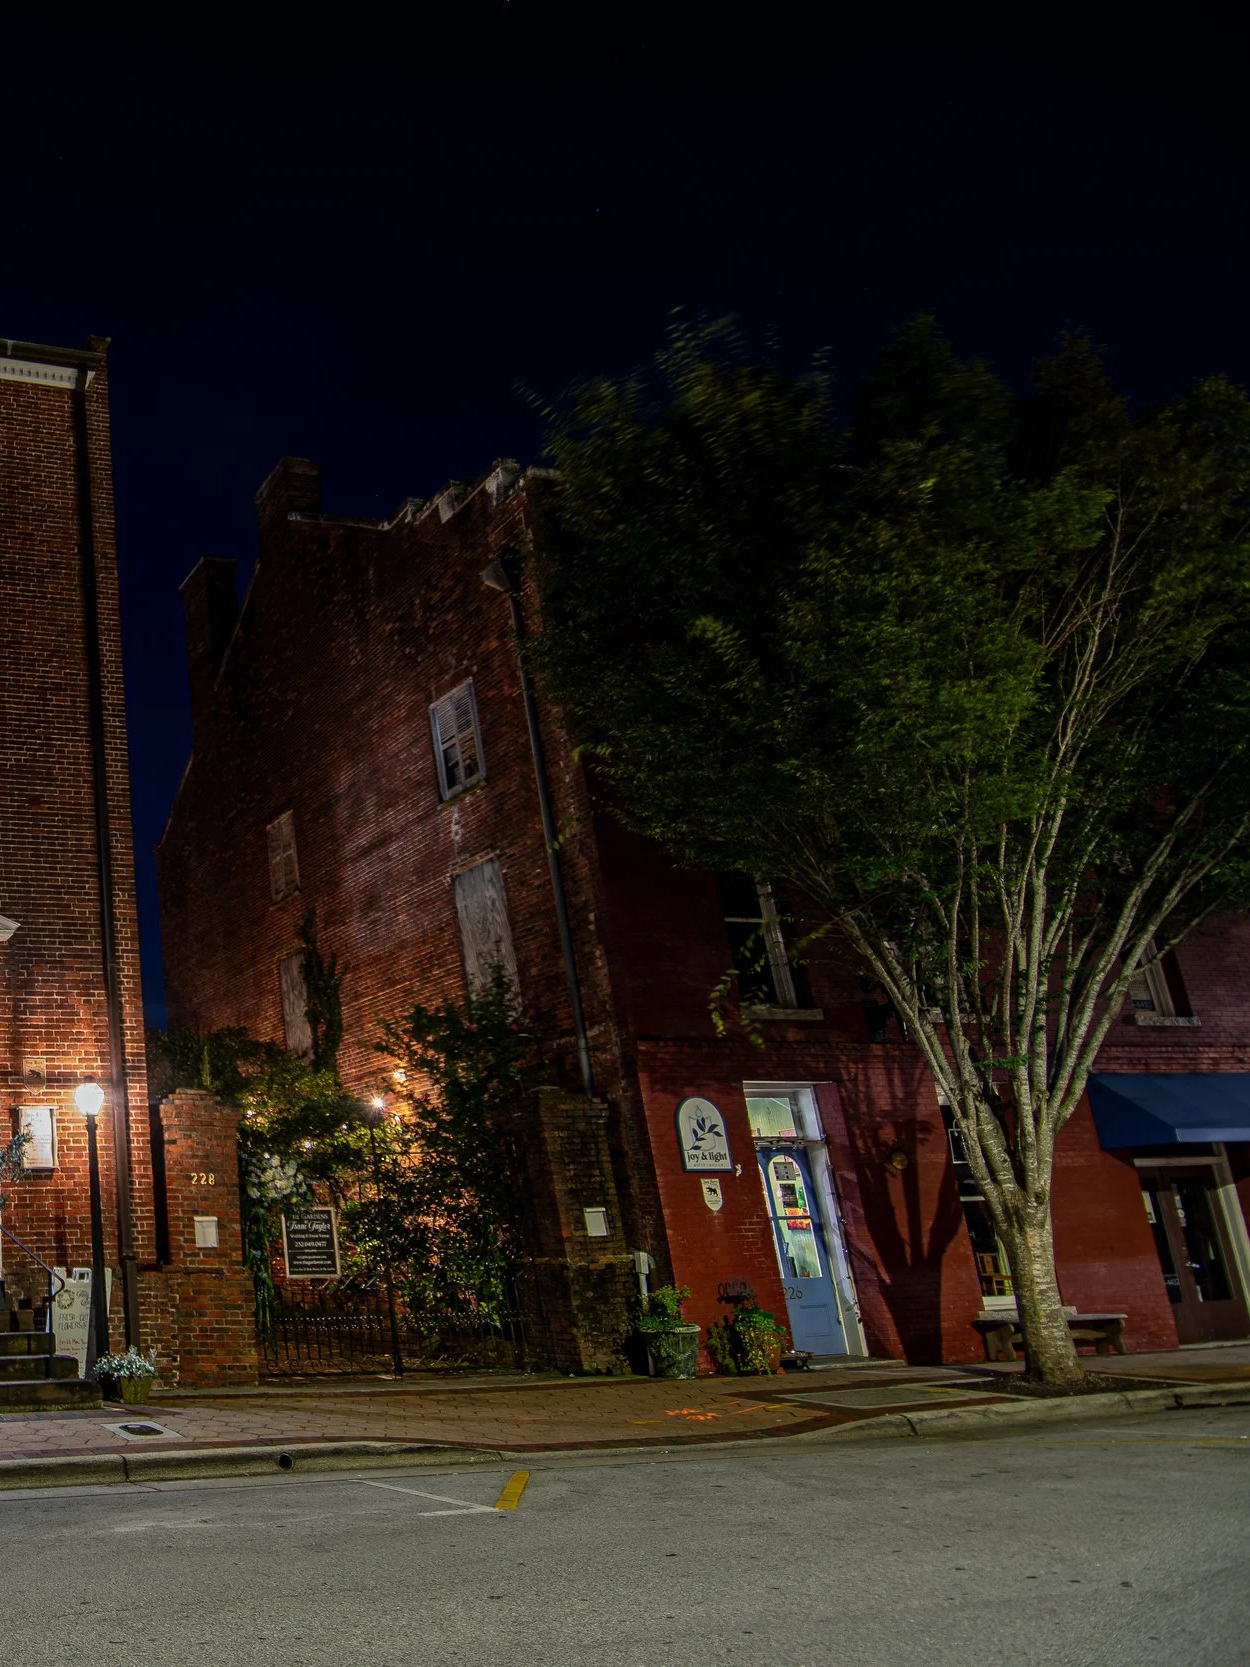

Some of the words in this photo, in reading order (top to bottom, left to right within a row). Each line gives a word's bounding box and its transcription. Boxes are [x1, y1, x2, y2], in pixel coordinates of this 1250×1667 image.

[687, 1151, 700, 1163] joy
[701, 1151, 709, 1161] &
[709, 1151, 728, 1163] light
[190, 1172, 215, 1186] 228
[308, 1220, 331, 1232] Taylor
